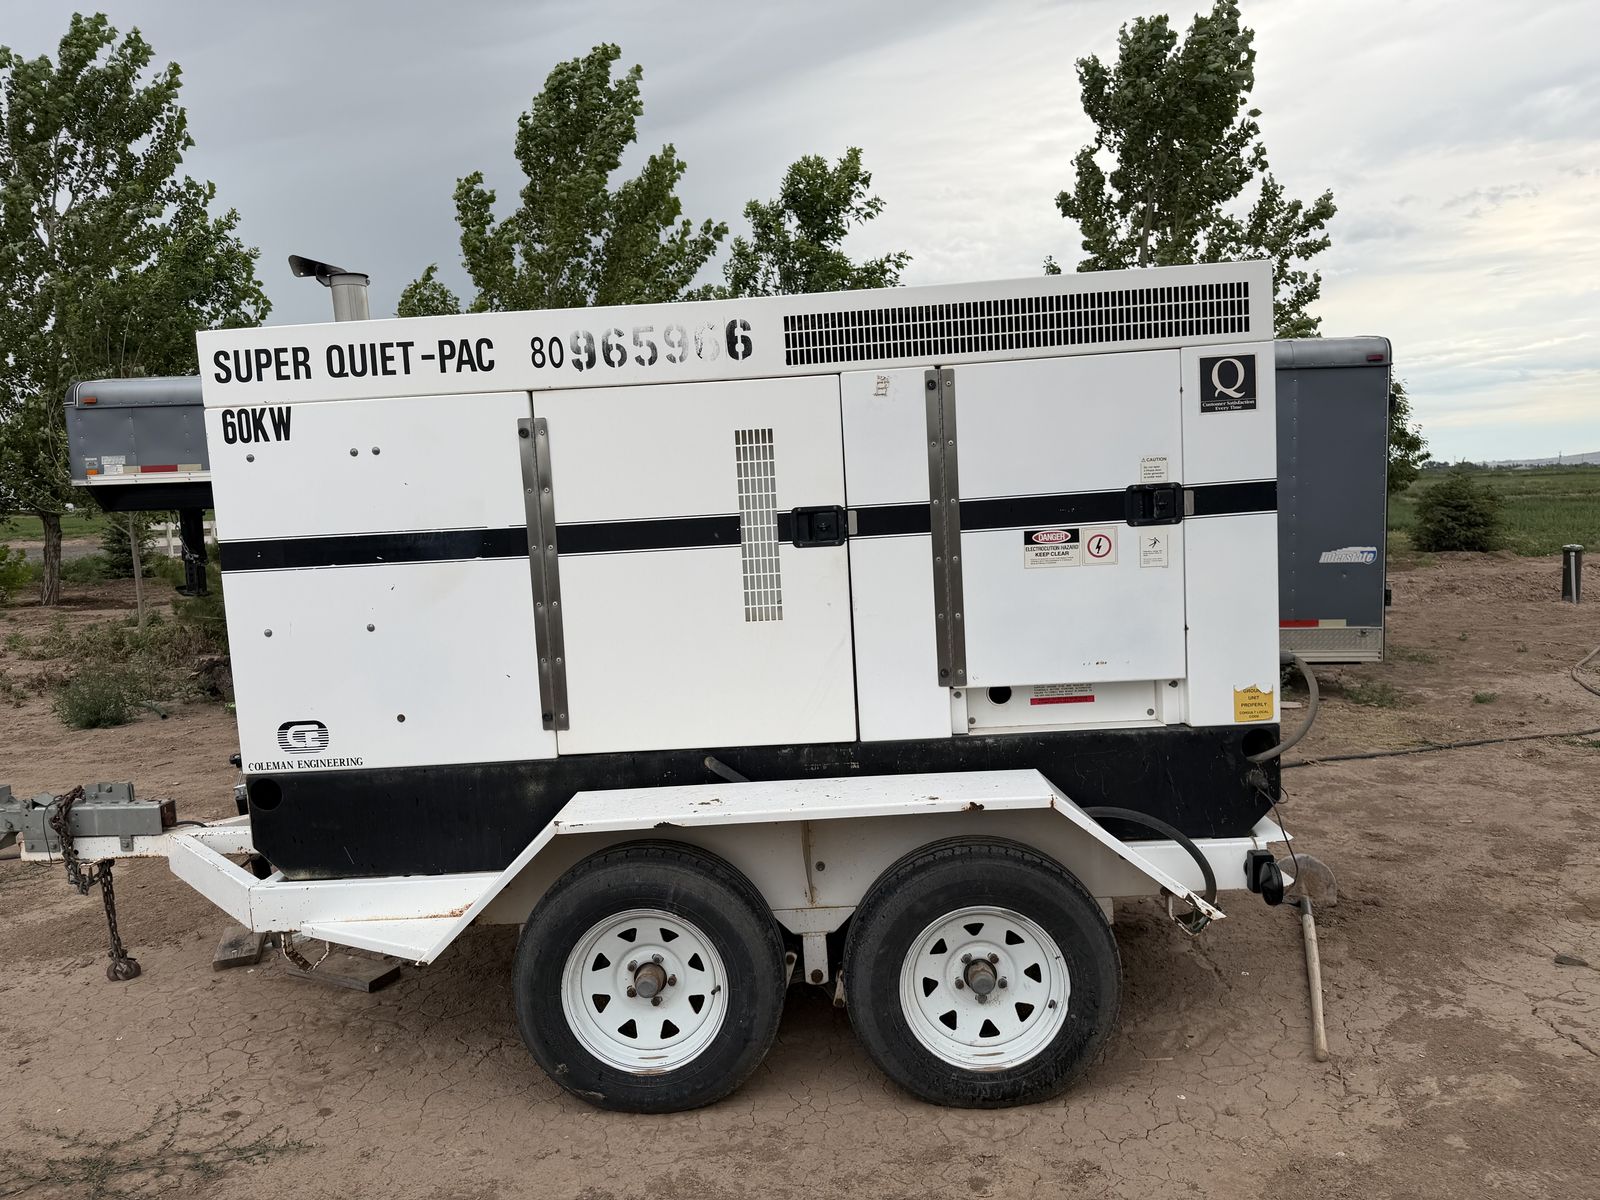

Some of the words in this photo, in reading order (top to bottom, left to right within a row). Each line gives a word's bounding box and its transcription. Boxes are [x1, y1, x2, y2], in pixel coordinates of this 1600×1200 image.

[213, 346, 312, 384] SUPER
[326, 338, 495, 378] QUIET-PAC
[1211, 358, 1245, 398] Q
[221, 406, 291, 444] 60KW
[1038, 532, 1065, 541] DANGER
[248, 761, 294, 771] COLEMAN
[297, 757, 363, 769] ENGINEERING
